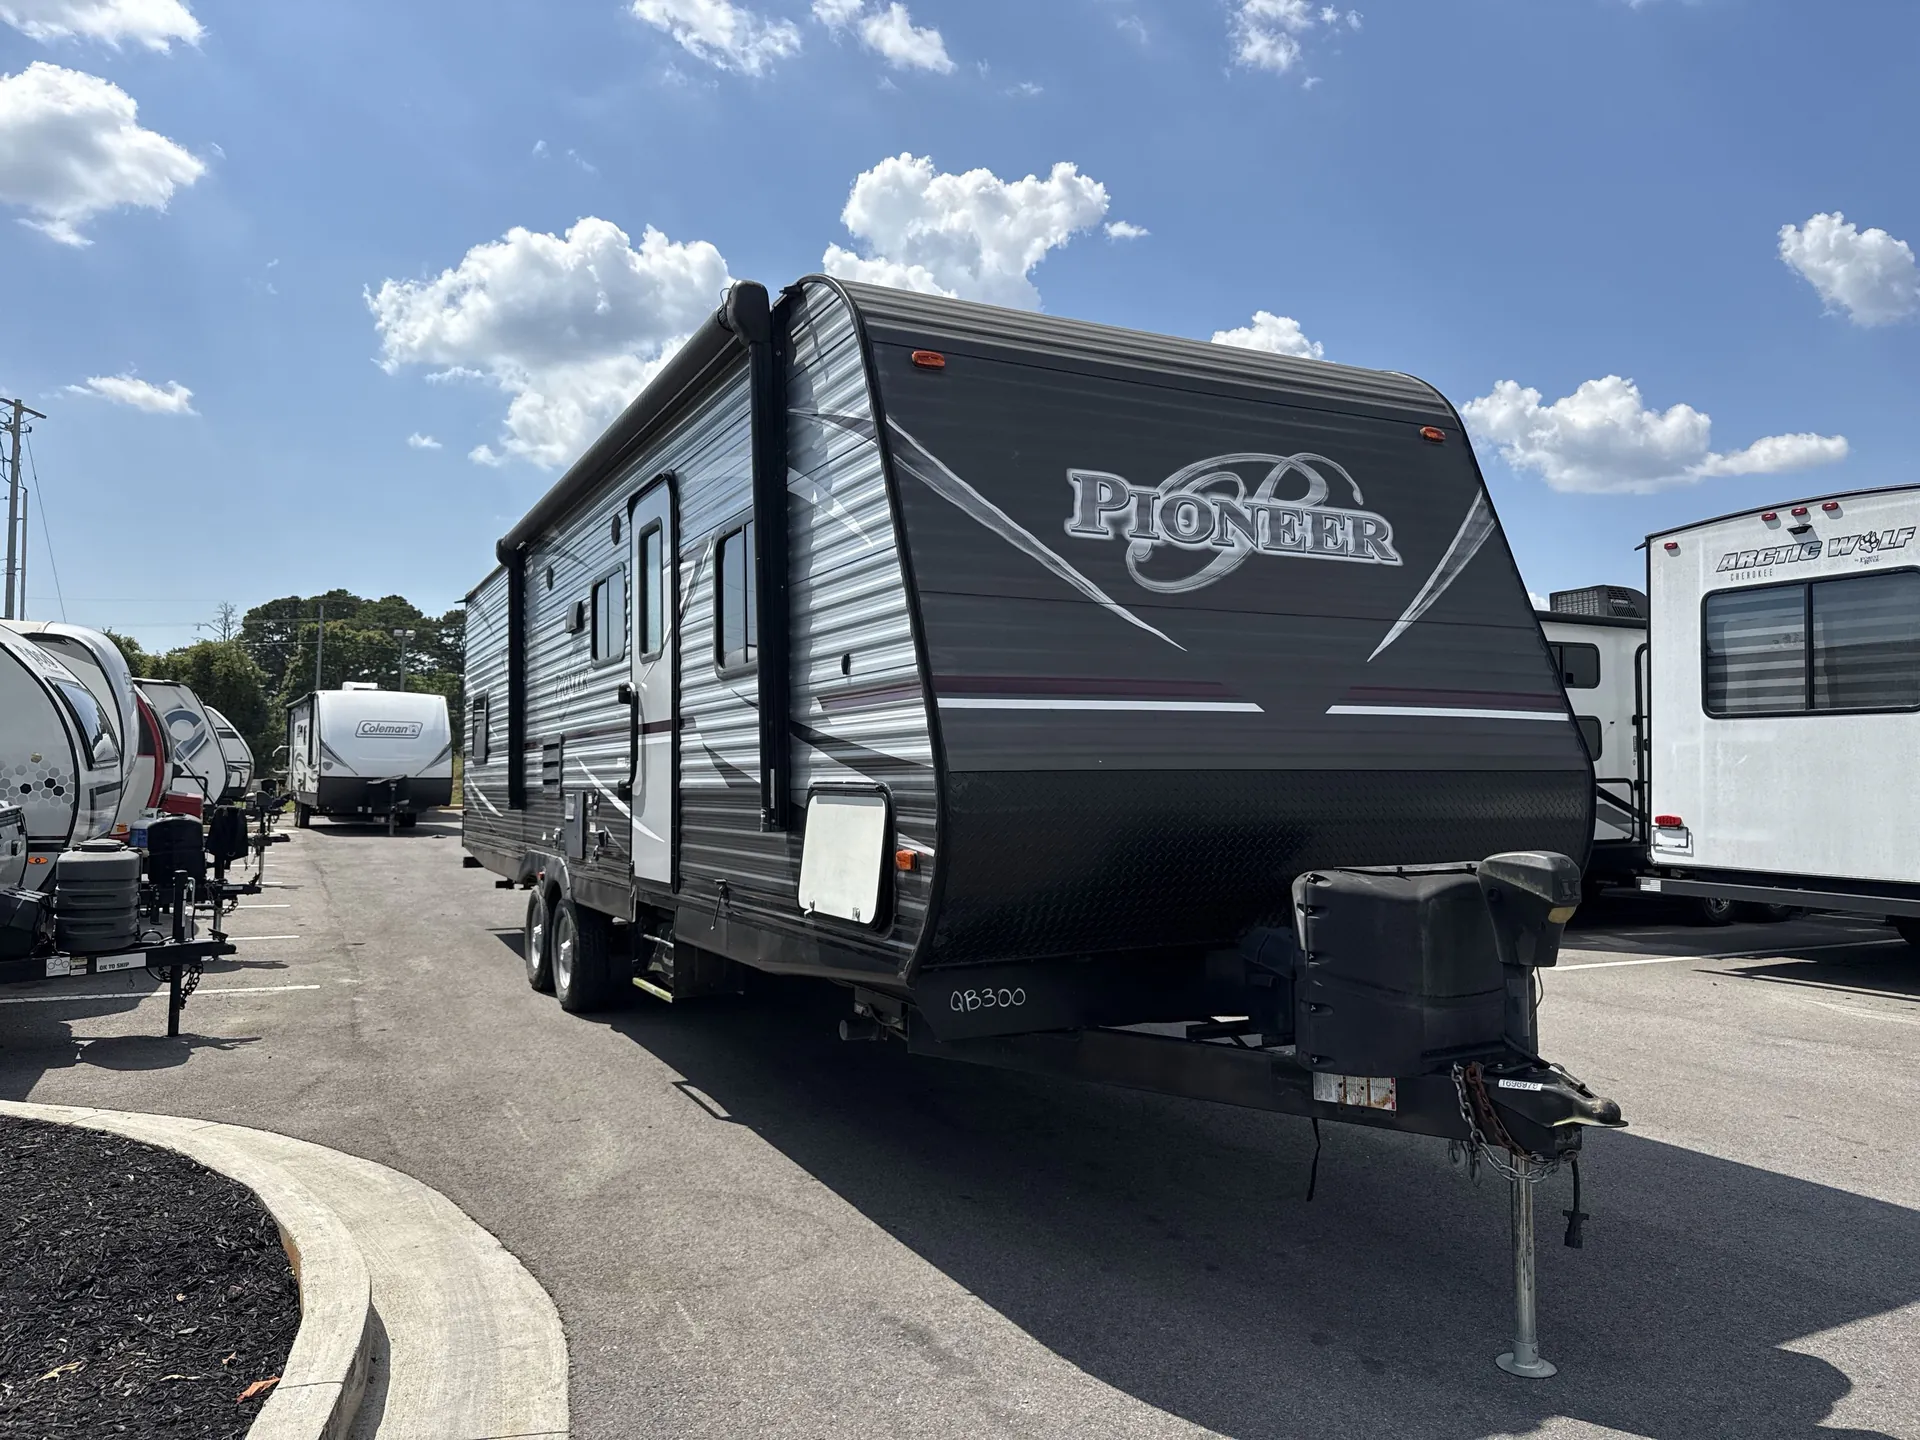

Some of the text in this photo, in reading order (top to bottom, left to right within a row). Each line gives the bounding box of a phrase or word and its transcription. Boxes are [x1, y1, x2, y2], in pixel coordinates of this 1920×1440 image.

[1067, 469, 1401, 565] PIONEER
[1716, 541, 1823, 572] ARCTIC
[1730, 569, 1774, 581] CHEROKEE
[361, 722, 408, 733] Coleman
[950, 988, 1026, 1012] QB300
